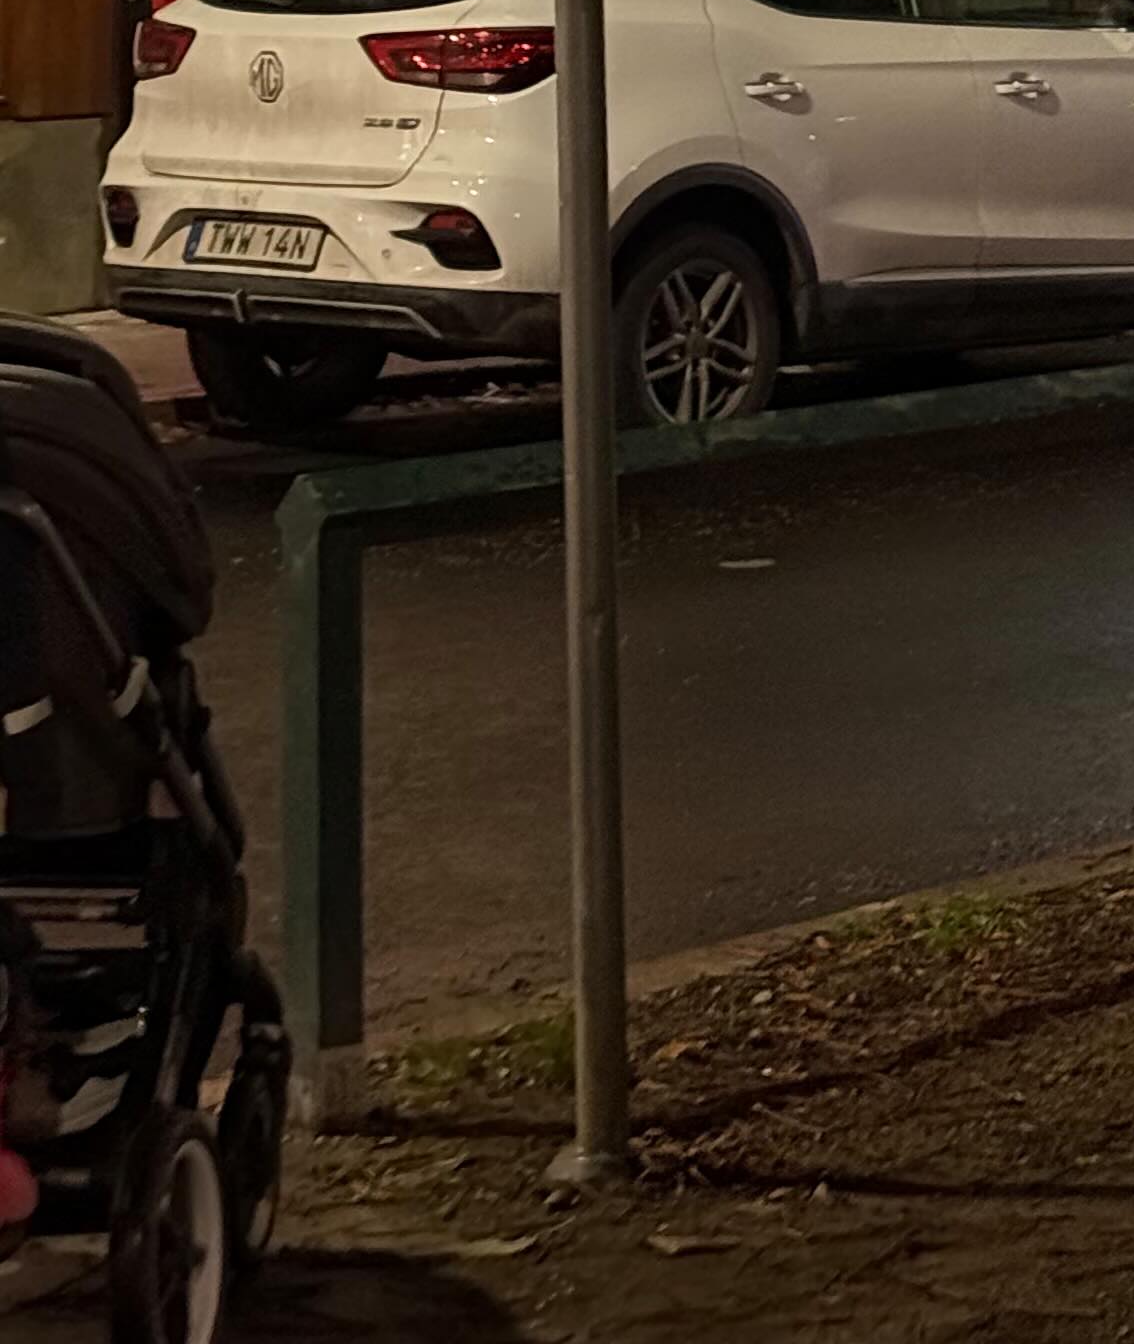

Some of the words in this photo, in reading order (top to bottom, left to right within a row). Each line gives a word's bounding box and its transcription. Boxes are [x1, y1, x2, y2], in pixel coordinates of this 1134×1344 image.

[251, 56, 283, 98] MG
[207, 223, 257, 254] TWW
[262, 227, 312, 259] 14N
